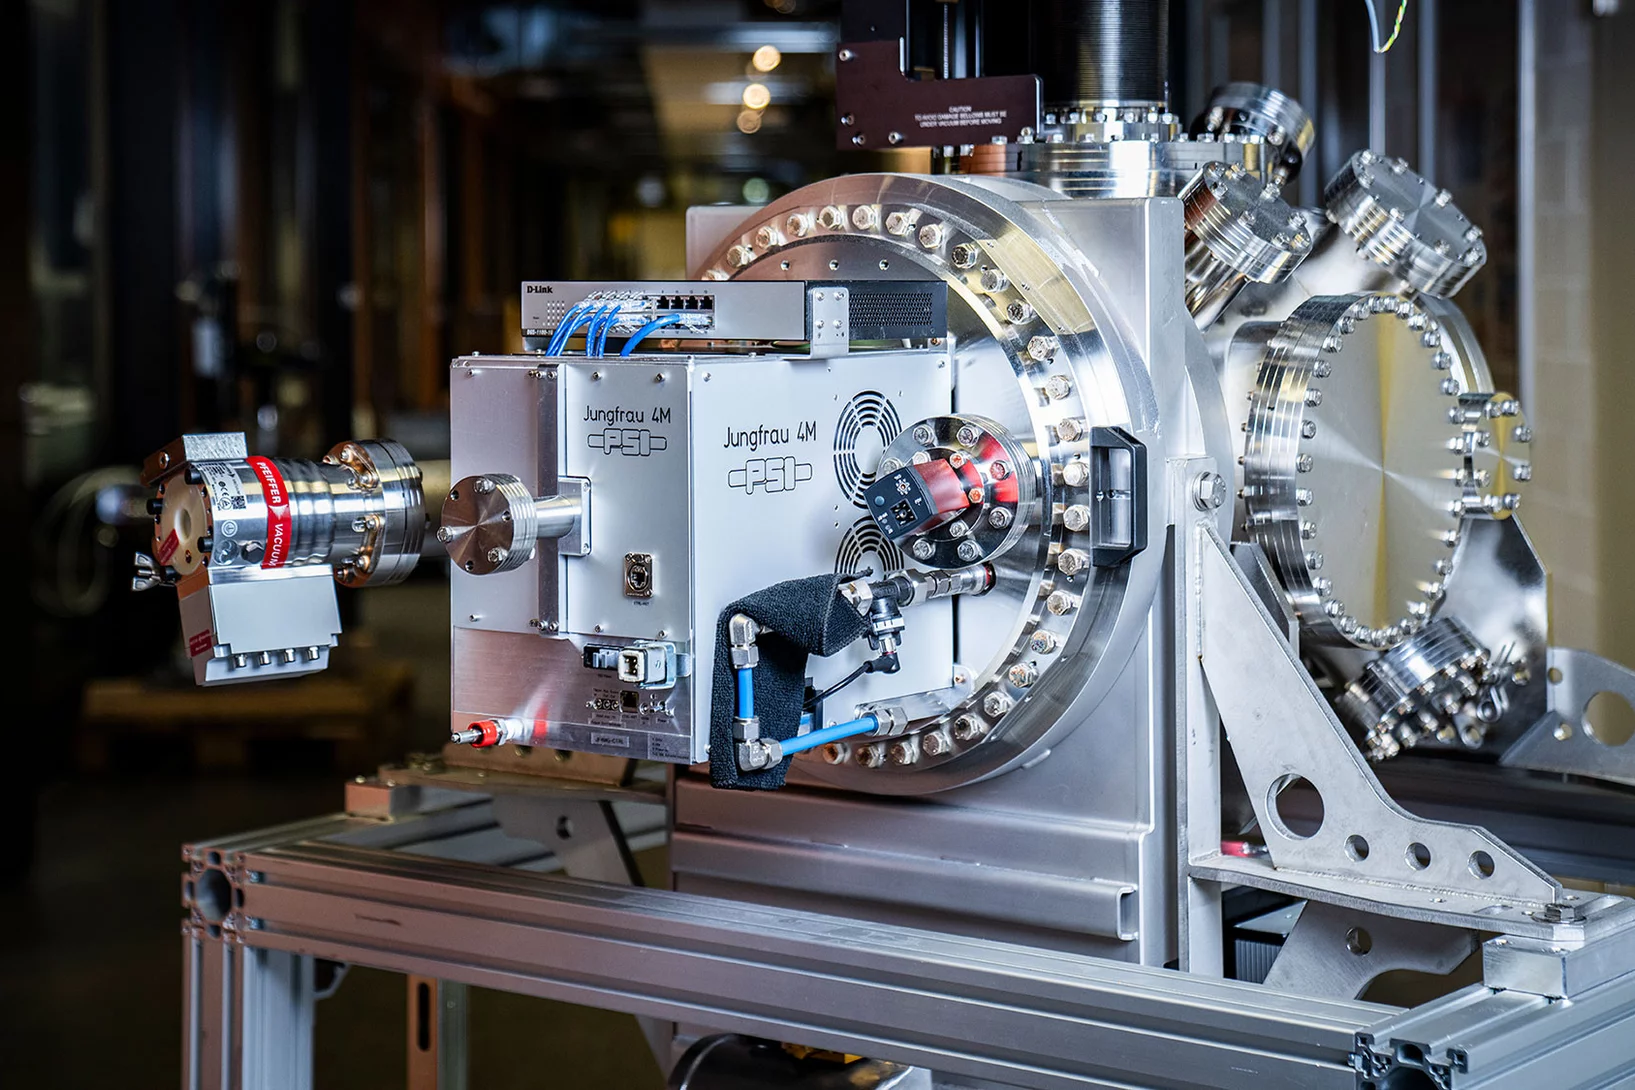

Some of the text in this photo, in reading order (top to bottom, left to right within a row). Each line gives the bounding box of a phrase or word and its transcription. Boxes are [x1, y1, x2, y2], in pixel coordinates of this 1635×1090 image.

[526, 285, 553, 294] D-Link
[583, 405, 671, 426] Jungfrau 4M
[603, 428, 651, 457] PSI
[723, 420, 816, 452] Jungfrau 4M
[256, 461, 282, 505] PFEIFFER
[745, 456, 796, 495] PSI
[268, 523, 284, 567] VACUUM
